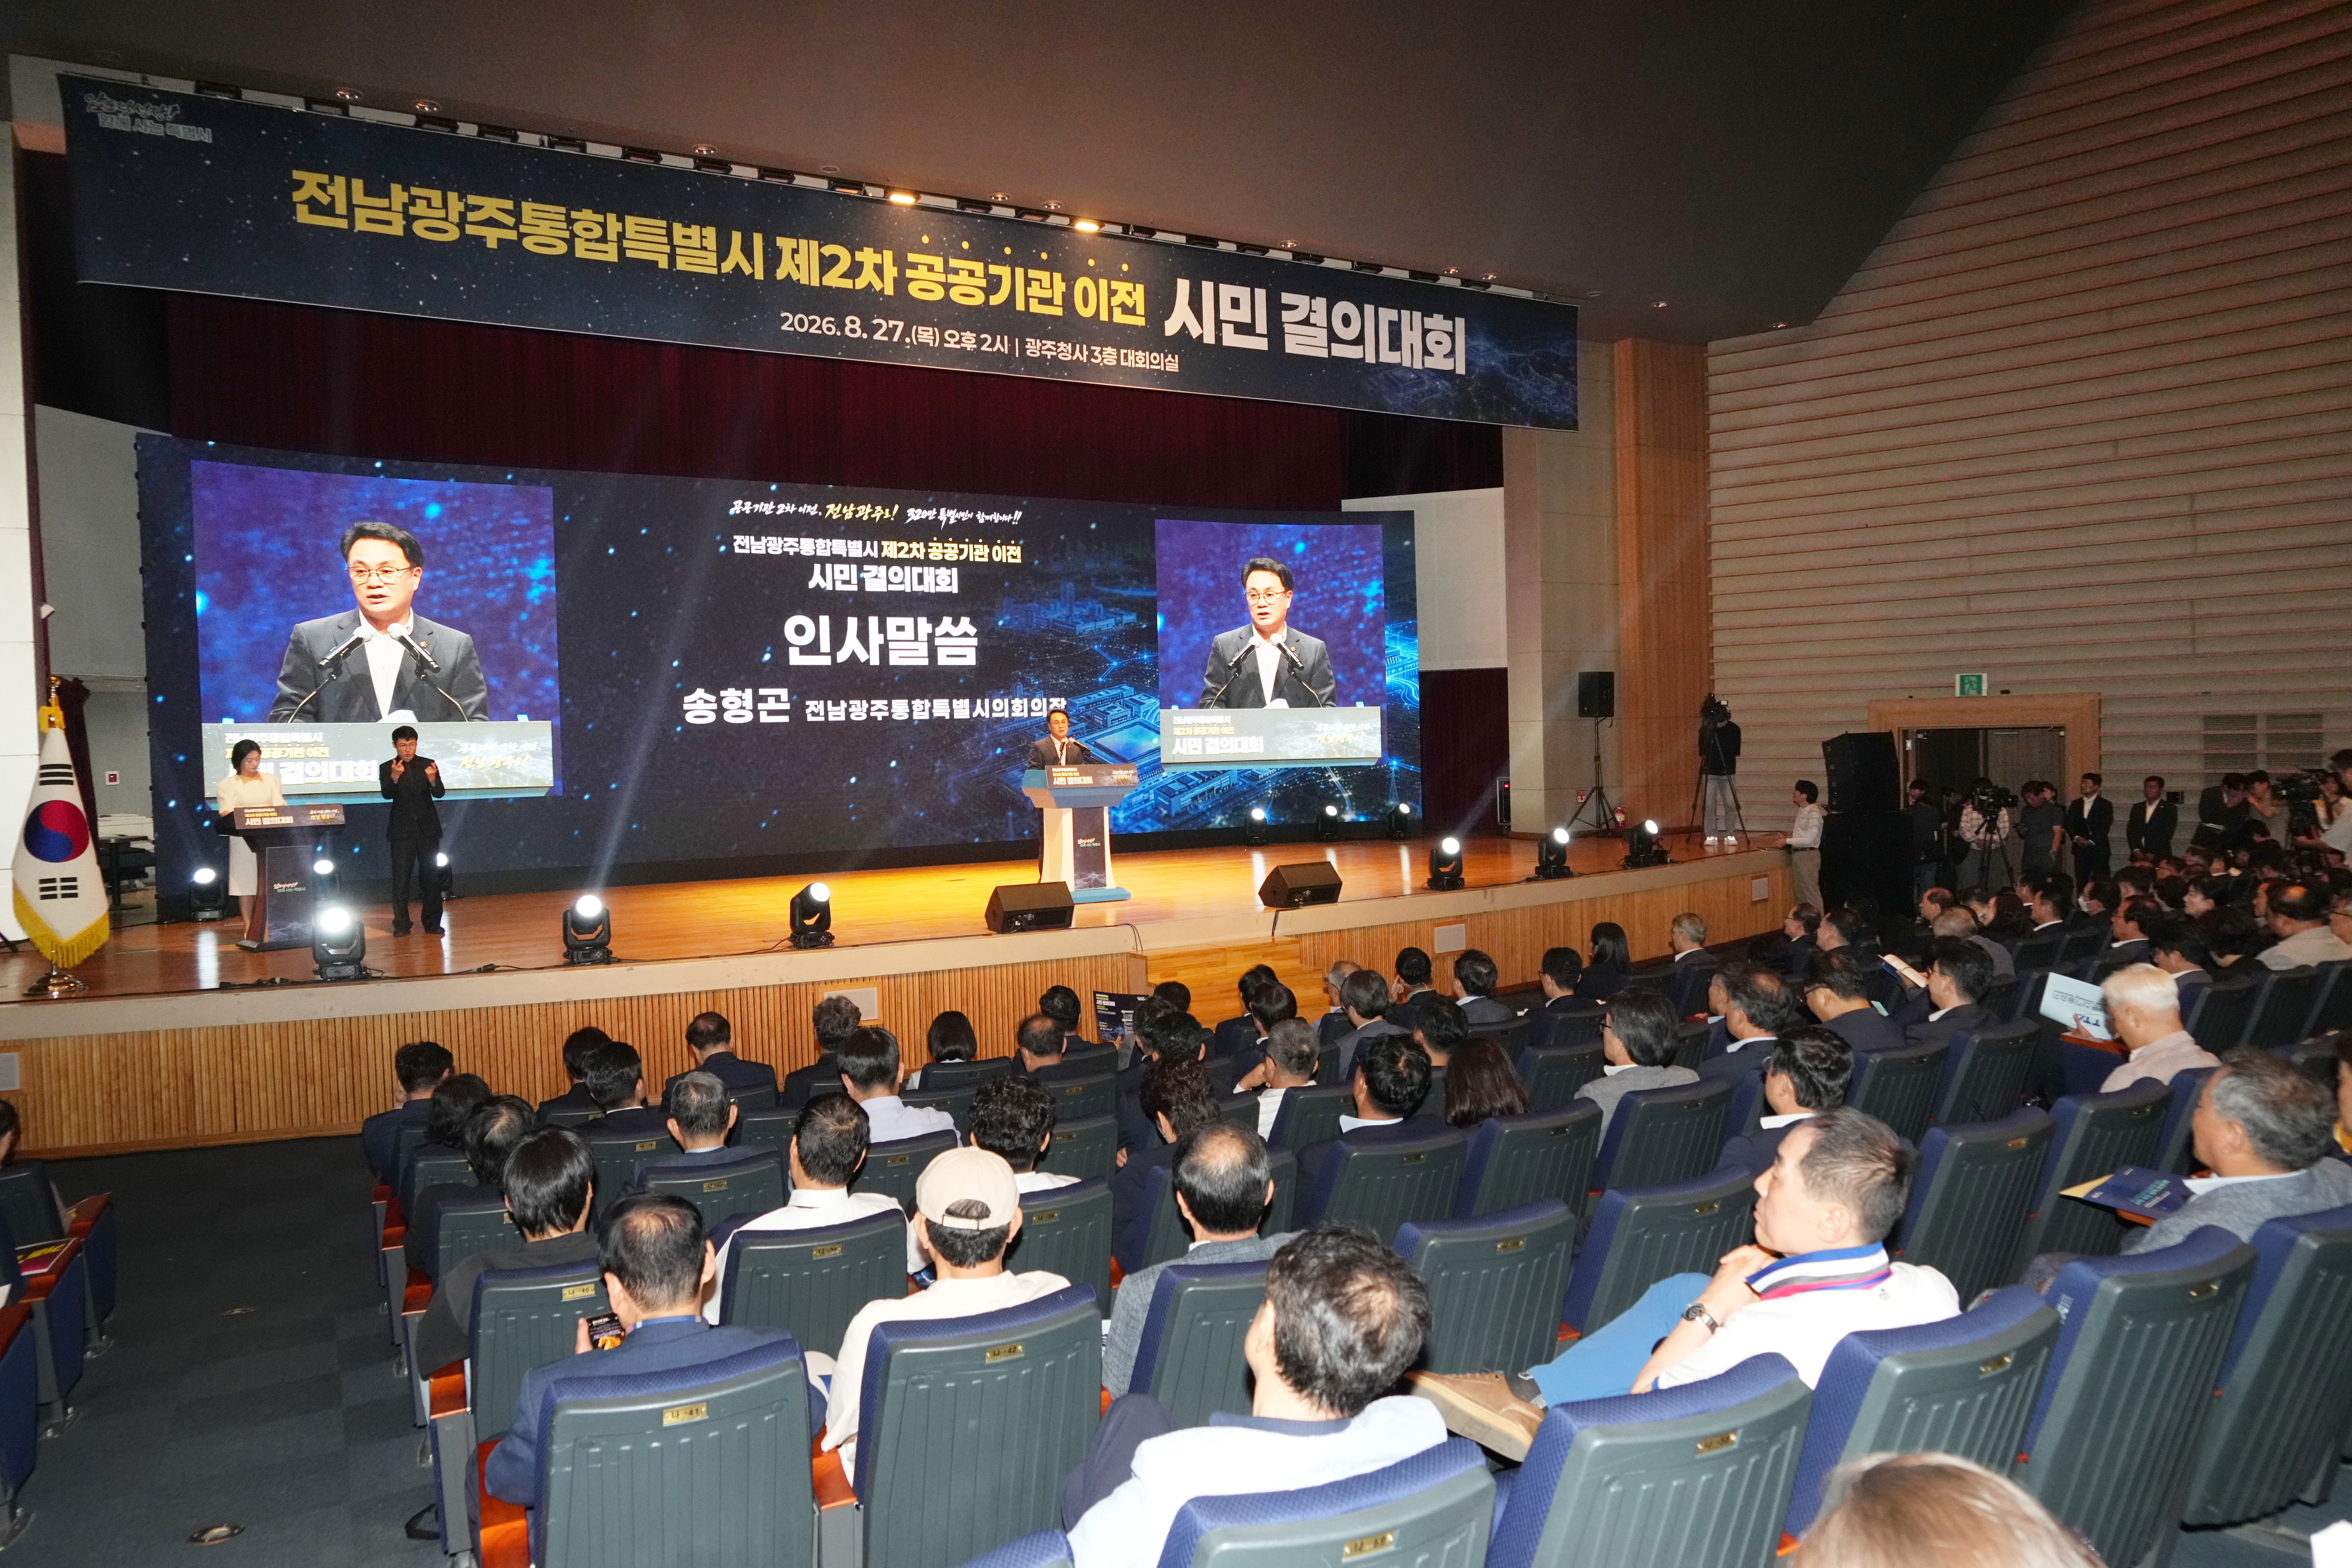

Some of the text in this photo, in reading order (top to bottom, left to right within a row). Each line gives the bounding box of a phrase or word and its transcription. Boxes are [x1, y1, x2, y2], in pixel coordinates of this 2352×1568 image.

[291, 169, 1466, 375] 전남광주통합특별시 제2차 공공기관 이전 시민 결의대회
[781, 312, 841, 336] 2026.
[845, 316, 867, 340] 8.
[944, 330, 977, 351] 오후
[980, 334, 1008, 354] 2시
[1025, 338, 1088, 363] 광주청사
[1091, 345, 1117, 366] 3층
[1120, 349, 1179, 372] 대회의실
[730, 500, 1022, 530] 공공기관 2차 이전, 전남광주로! 320만 특별시민이 함께합니다!!
[733, 535, 1021, 563] 전남광주통합특별시 제2차 공공기관 이전
[808, 563, 959, 593] 시민 결의대회
[784, 615, 978, 666] 인사말씀
[683, 687, 790, 724] 송형곤
[306, 746, 330, 758] 이전
[1172, 736, 1264, 755] 시민 결의대회
[279, 760, 378, 785] 결의대회
[1067, 776, 1093, 784] 결의대회
[262, 816, 294, 825] 결의대회
